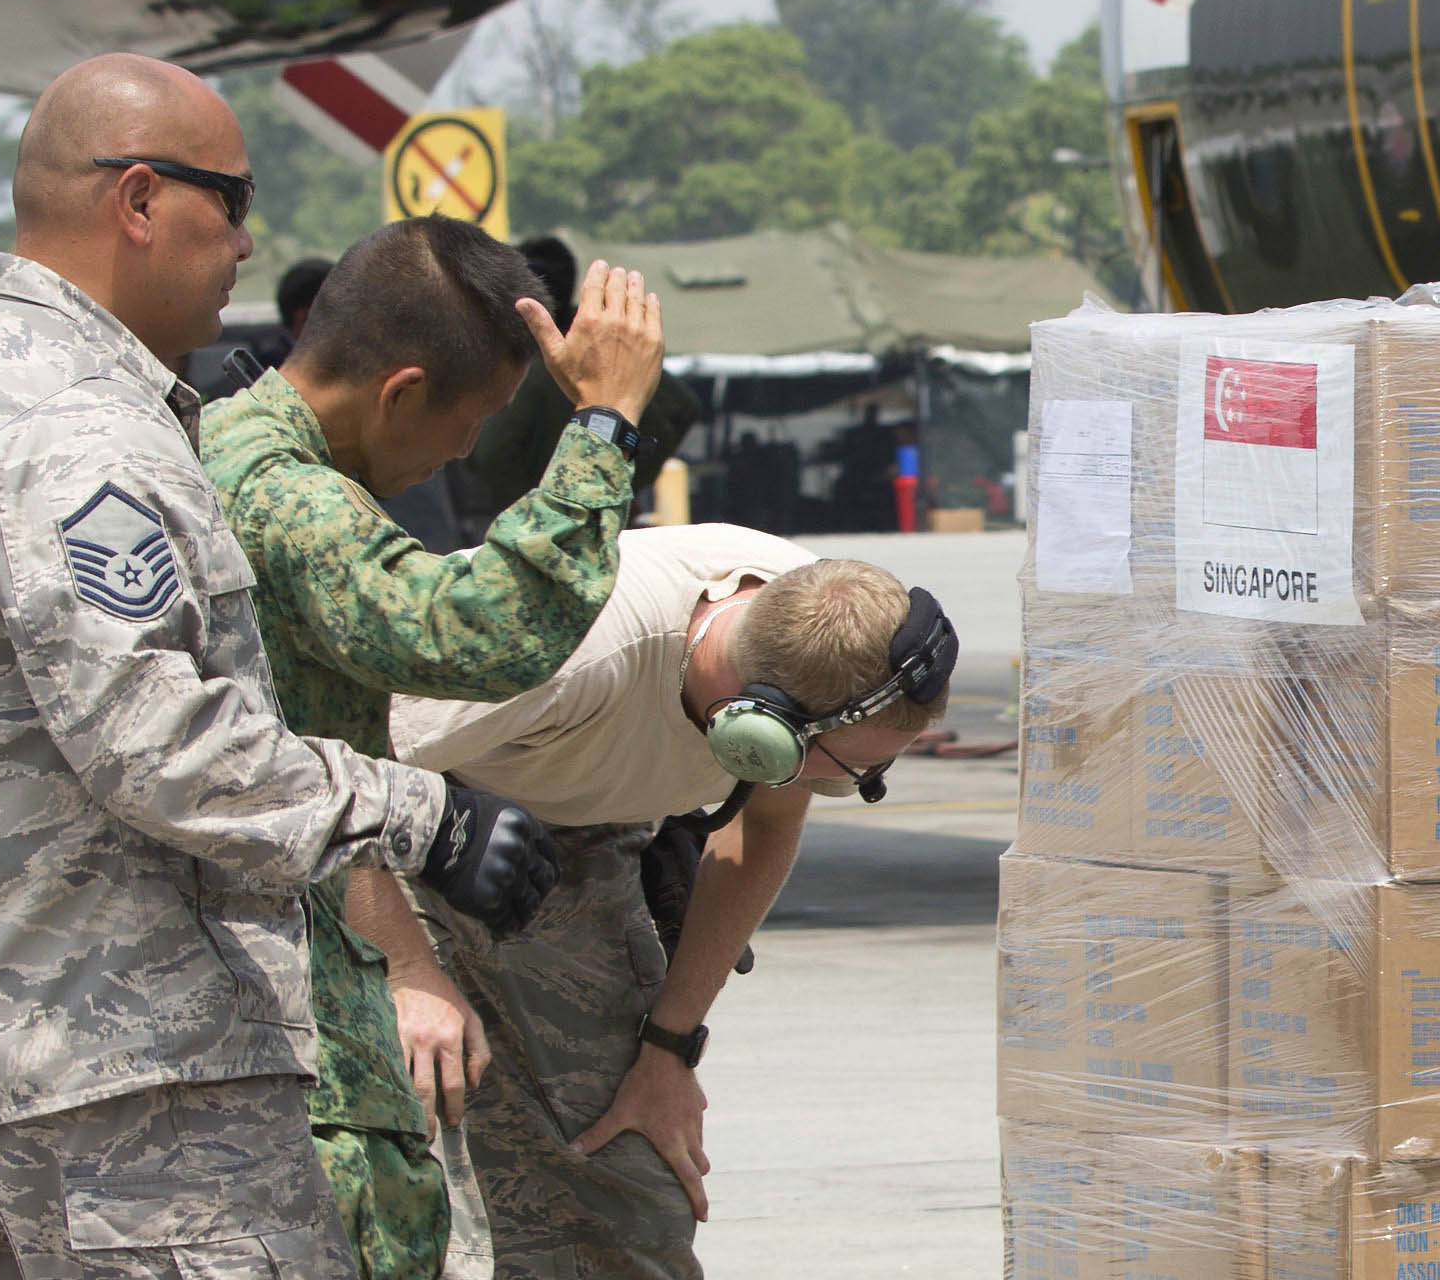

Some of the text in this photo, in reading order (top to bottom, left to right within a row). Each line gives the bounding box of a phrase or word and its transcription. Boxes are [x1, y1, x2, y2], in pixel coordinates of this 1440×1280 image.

[1203, 560, 1319, 603] SINGAPORE
[1395, 1202, 1427, 1225] ONE
[1395, 1231, 1429, 1253] NON
